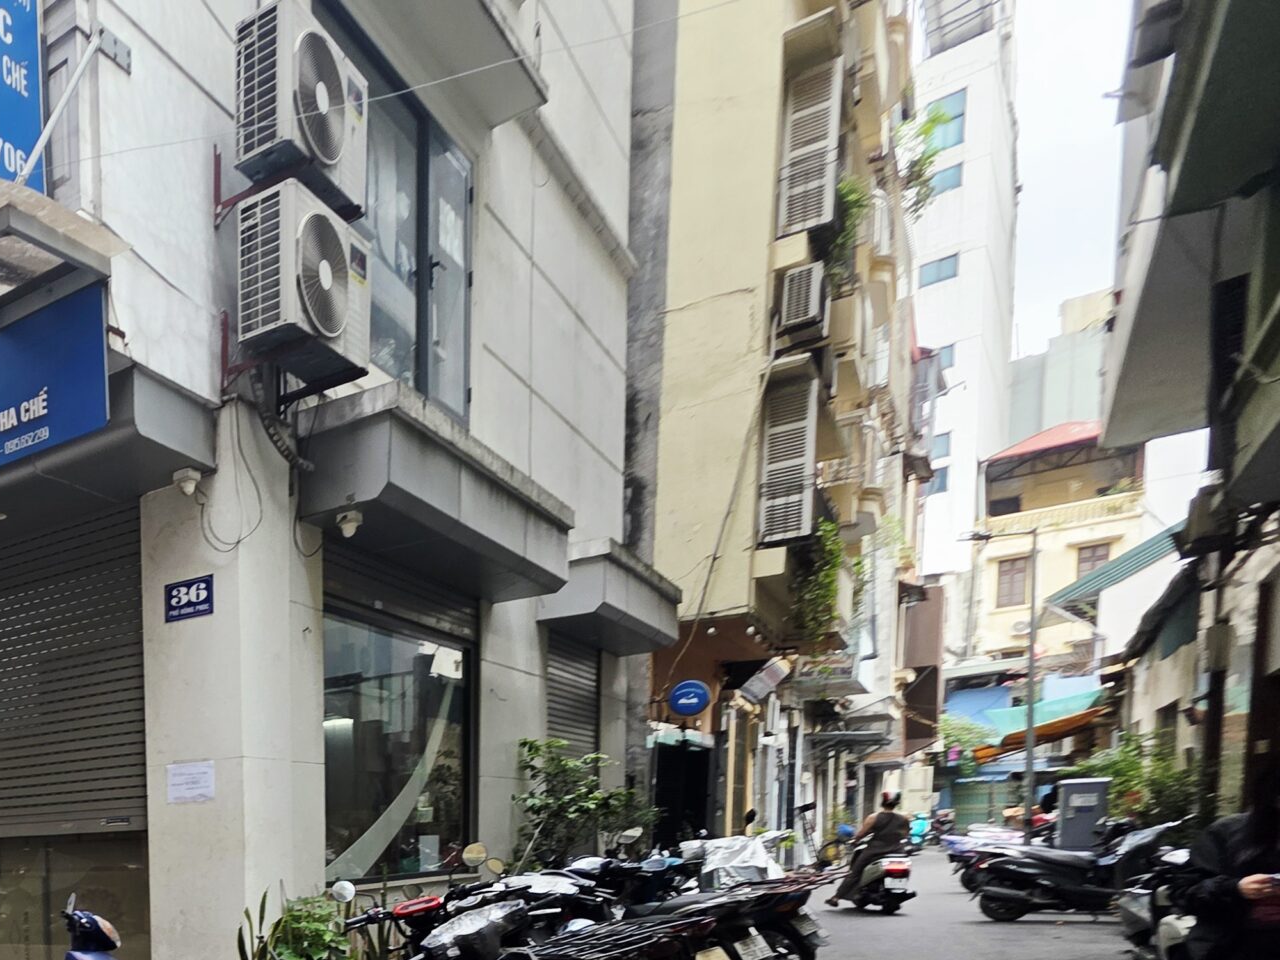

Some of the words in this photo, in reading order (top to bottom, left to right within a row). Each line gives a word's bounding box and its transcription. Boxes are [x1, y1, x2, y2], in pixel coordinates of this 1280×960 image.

[2, 55, 29, 97] CHẾ
[20, 386, 48, 423] CHẾ
[171, 582, 208, 607] 36
